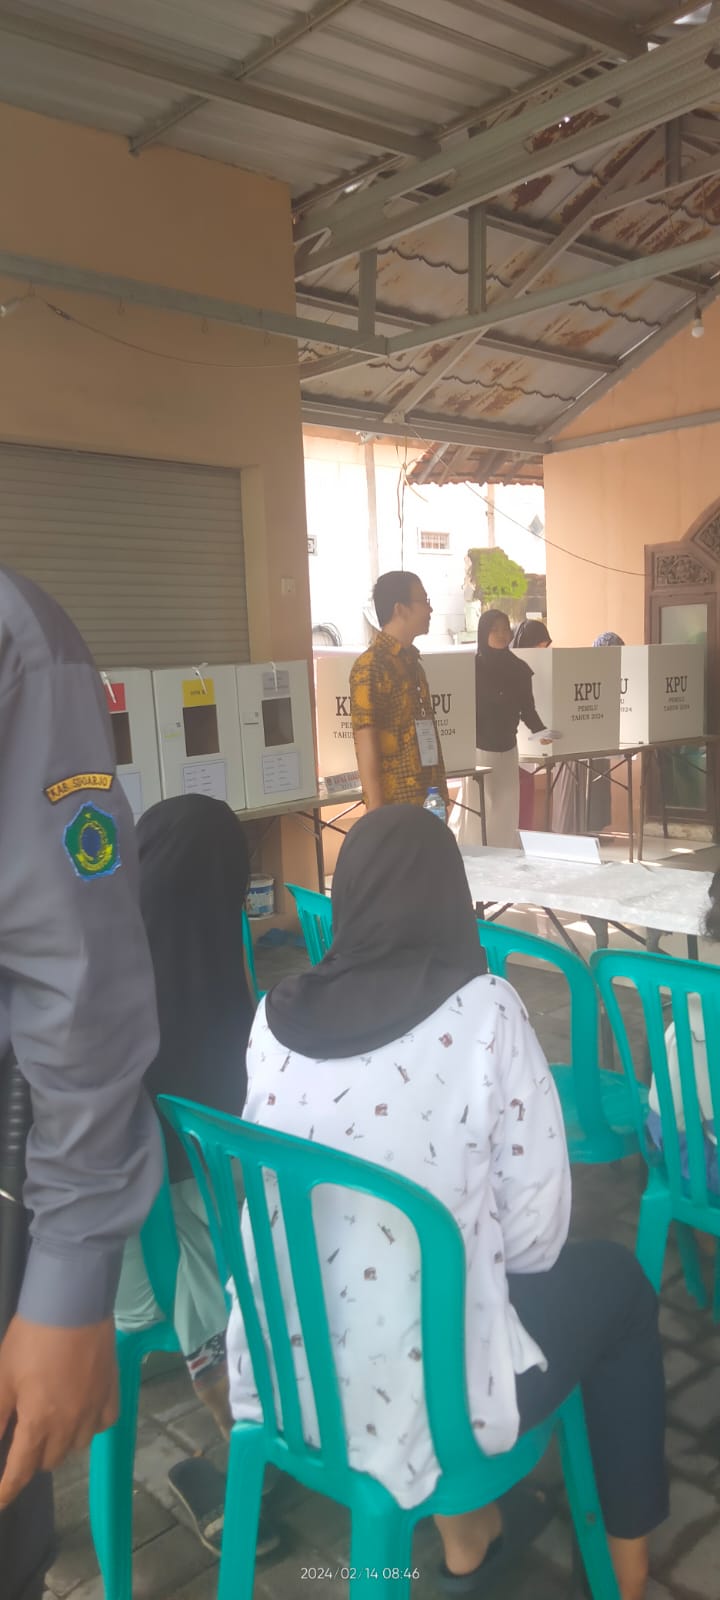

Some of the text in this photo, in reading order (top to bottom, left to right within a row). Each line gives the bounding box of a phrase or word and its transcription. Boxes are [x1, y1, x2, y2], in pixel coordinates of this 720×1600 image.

[574, 682, 602, 702] KPU
[665, 675, 688, 694] KPU
[431, 693, 452, 714] PU
[440, 728, 456, 736] 2024
